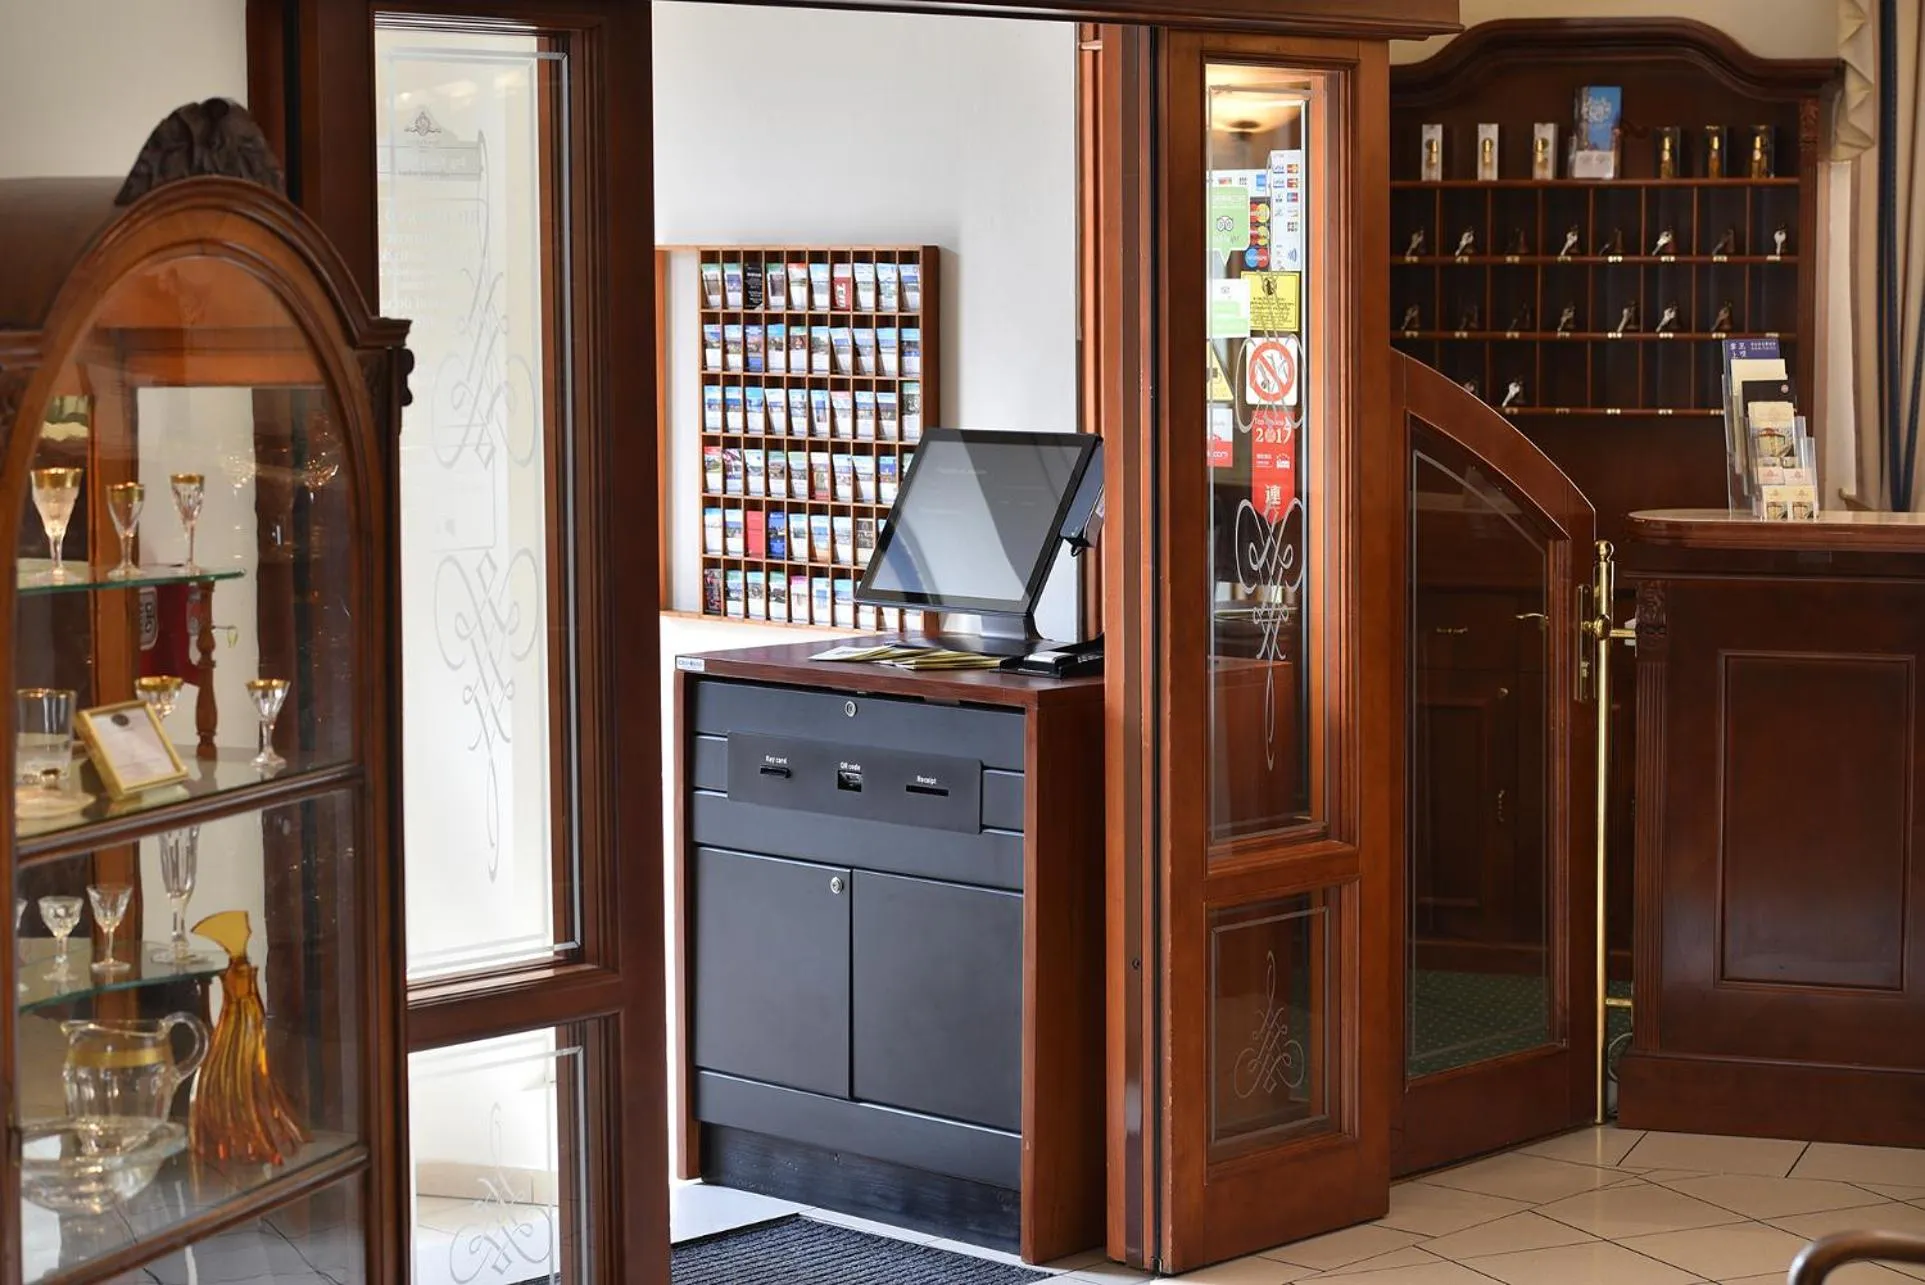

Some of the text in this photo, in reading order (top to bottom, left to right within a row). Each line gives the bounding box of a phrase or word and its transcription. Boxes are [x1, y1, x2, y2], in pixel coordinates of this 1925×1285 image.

[765, 755, 788, 765] Key card
[840, 761, 848, 769] QR
[916, 775, 936, 785] Receipt
